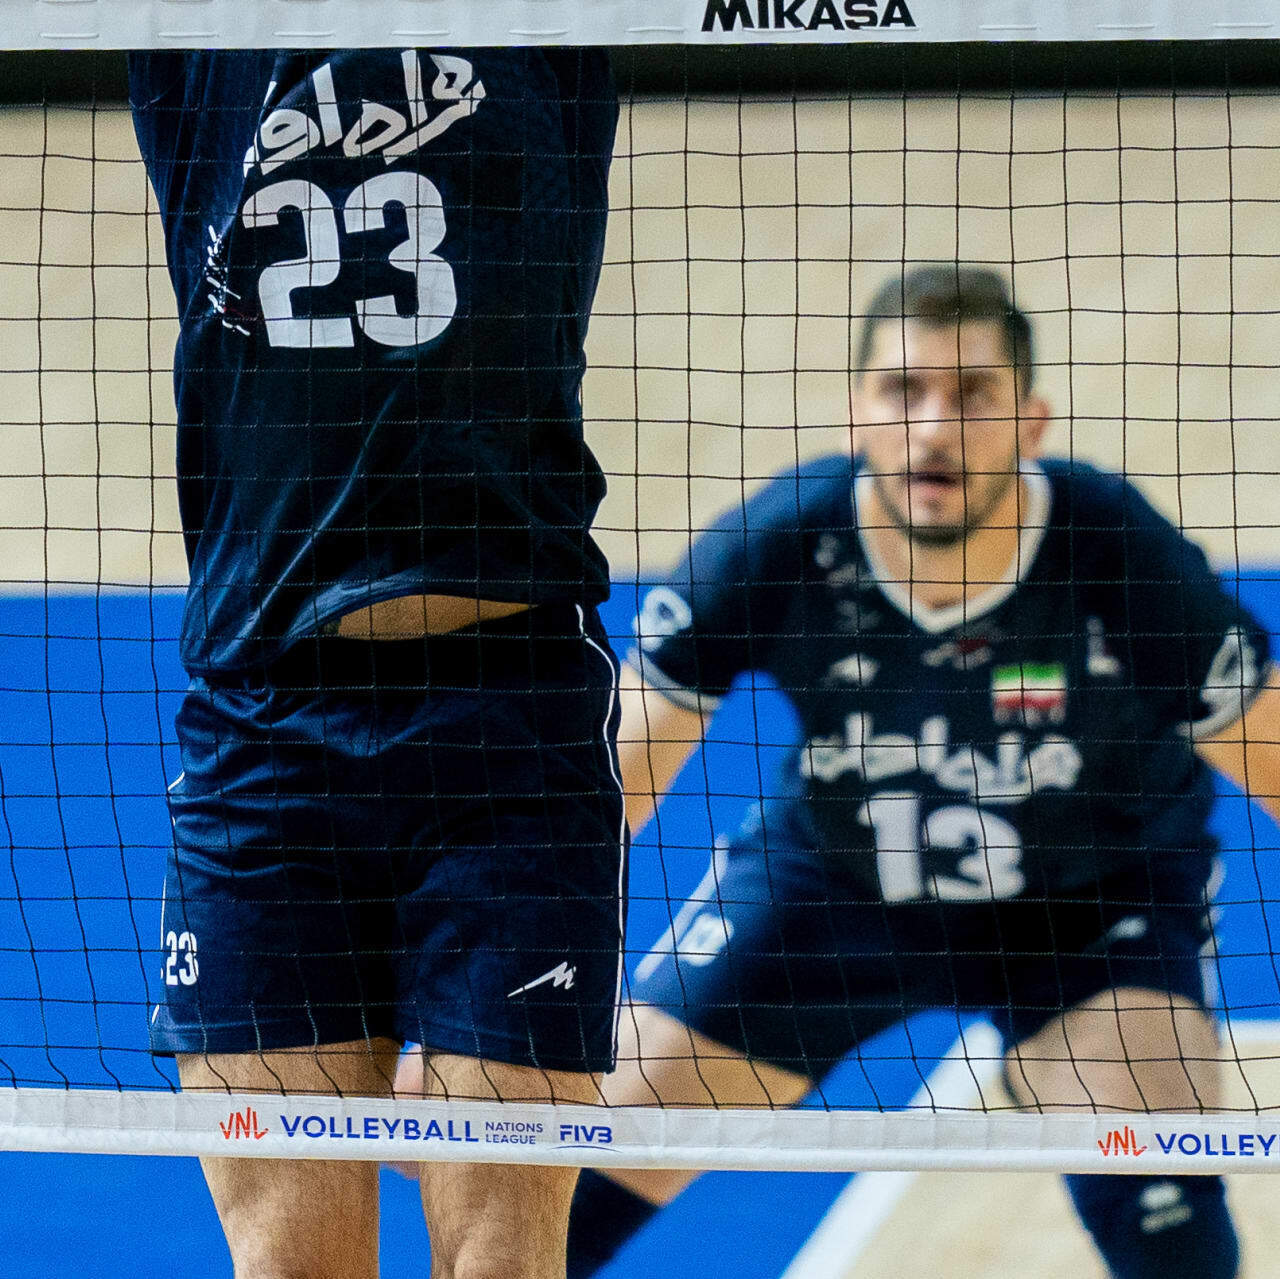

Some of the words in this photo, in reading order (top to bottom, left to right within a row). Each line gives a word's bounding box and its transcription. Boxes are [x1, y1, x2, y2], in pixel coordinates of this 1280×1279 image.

[242, 171, 458, 348] 23
[857, 791, 1024, 903] 13
[165, 930, 199, 986] 23
[220, 1106, 269, 1140] VNL
[280, 1115, 480, 1143] VOLLEYBALL
[485, 1121, 544, 1134] NATIONS
[486, 1135, 537, 1145] LEAGUE
[560, 1124, 613, 1144] FIVB
[1097, 1125, 1148, 1157] VNL
